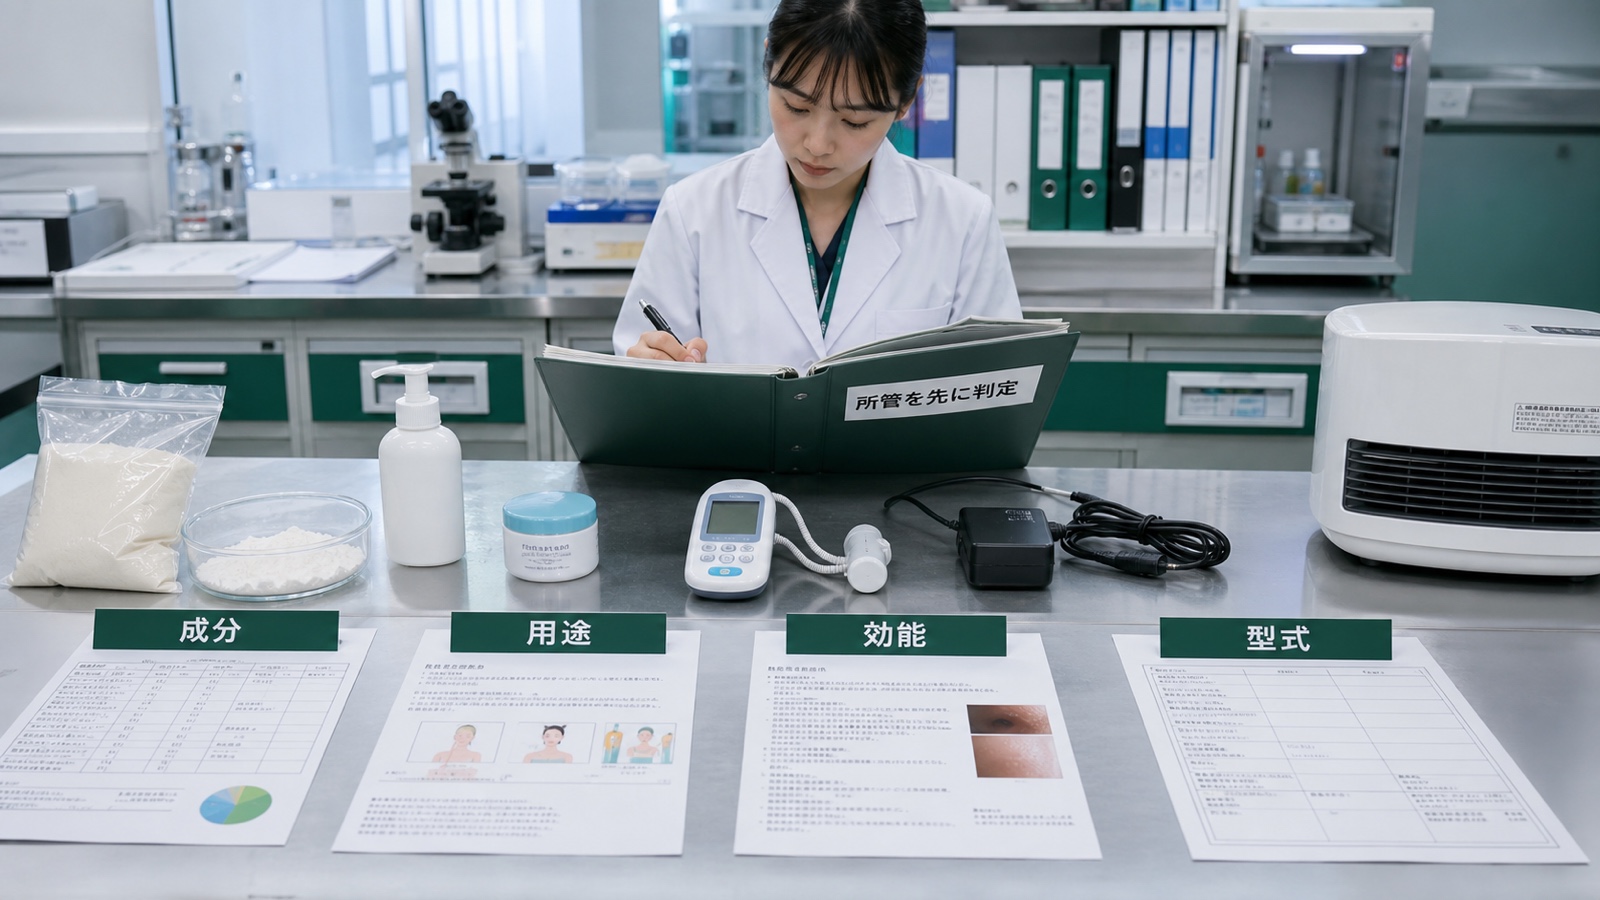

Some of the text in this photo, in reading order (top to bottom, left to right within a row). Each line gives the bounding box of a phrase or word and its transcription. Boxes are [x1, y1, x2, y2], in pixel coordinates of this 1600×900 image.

[855, 380, 1019, 411] 所管を先に判定
[179, 617, 242, 643] 成分
[526, 620, 592, 646] 用途
[863, 621, 927, 648] 効能
[1246, 625, 1311, 652] 型式
